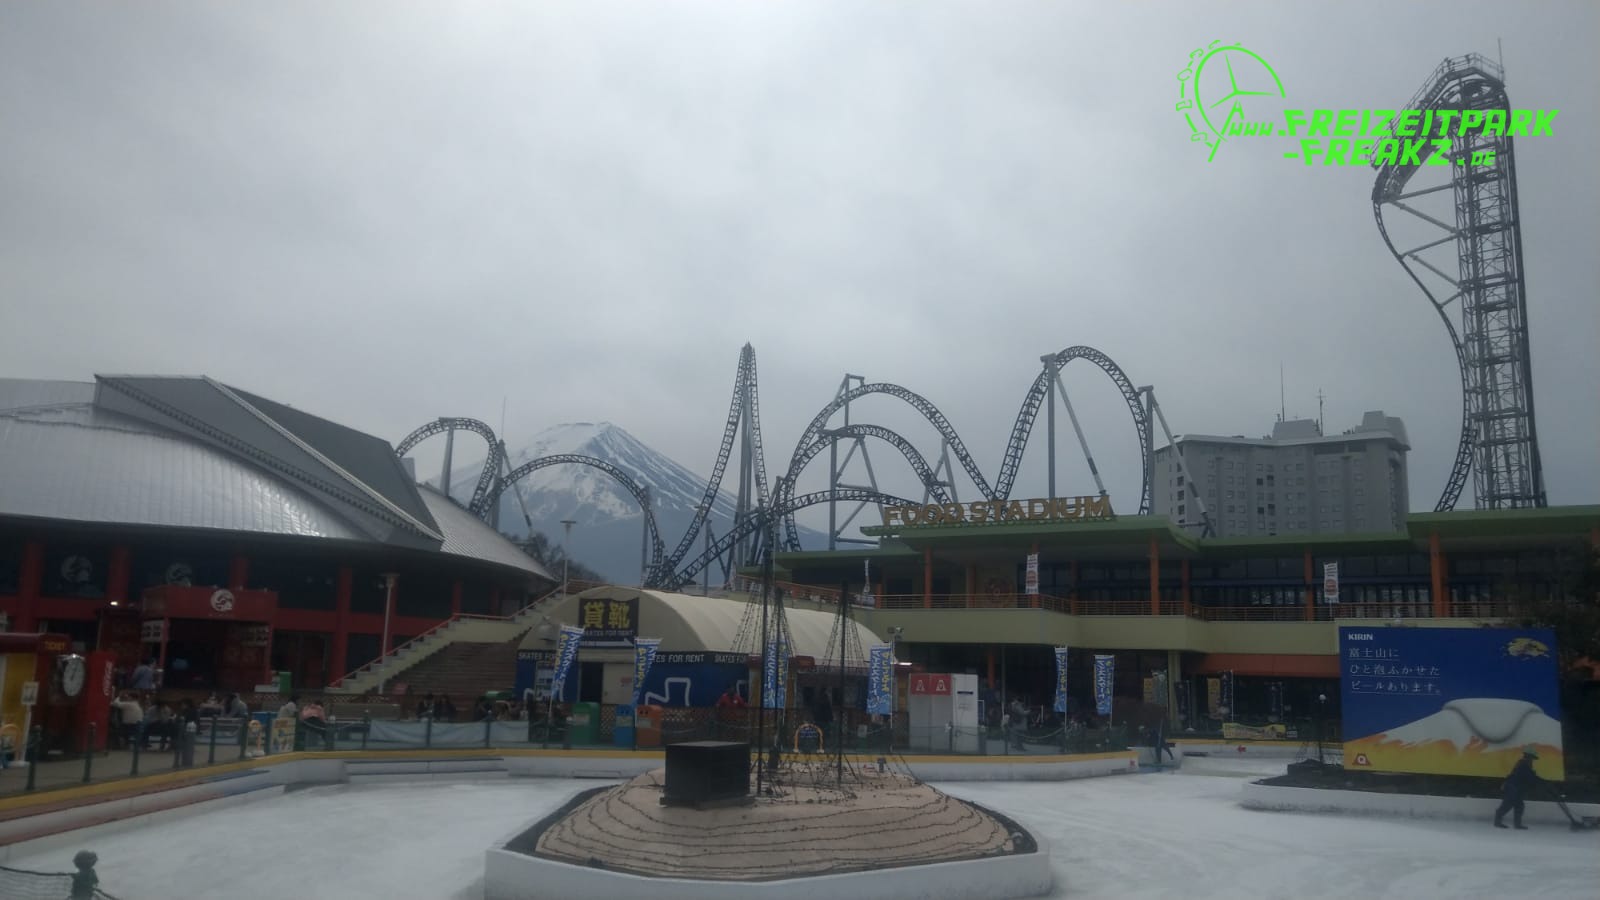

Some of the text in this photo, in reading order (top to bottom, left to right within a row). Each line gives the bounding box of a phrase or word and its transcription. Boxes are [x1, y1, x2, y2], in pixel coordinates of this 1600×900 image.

[883, 495, 1112, 526] FOOD STADIUM
[583, 601, 630, 629] 貸靴
[1348, 633, 1374, 641] KIRIN
[518, 652, 544, 661] SKATES
[1348, 647, 1400, 659] 富士山に
[668, 654, 683, 663] FOR
[685, 654, 705, 663] RENT
